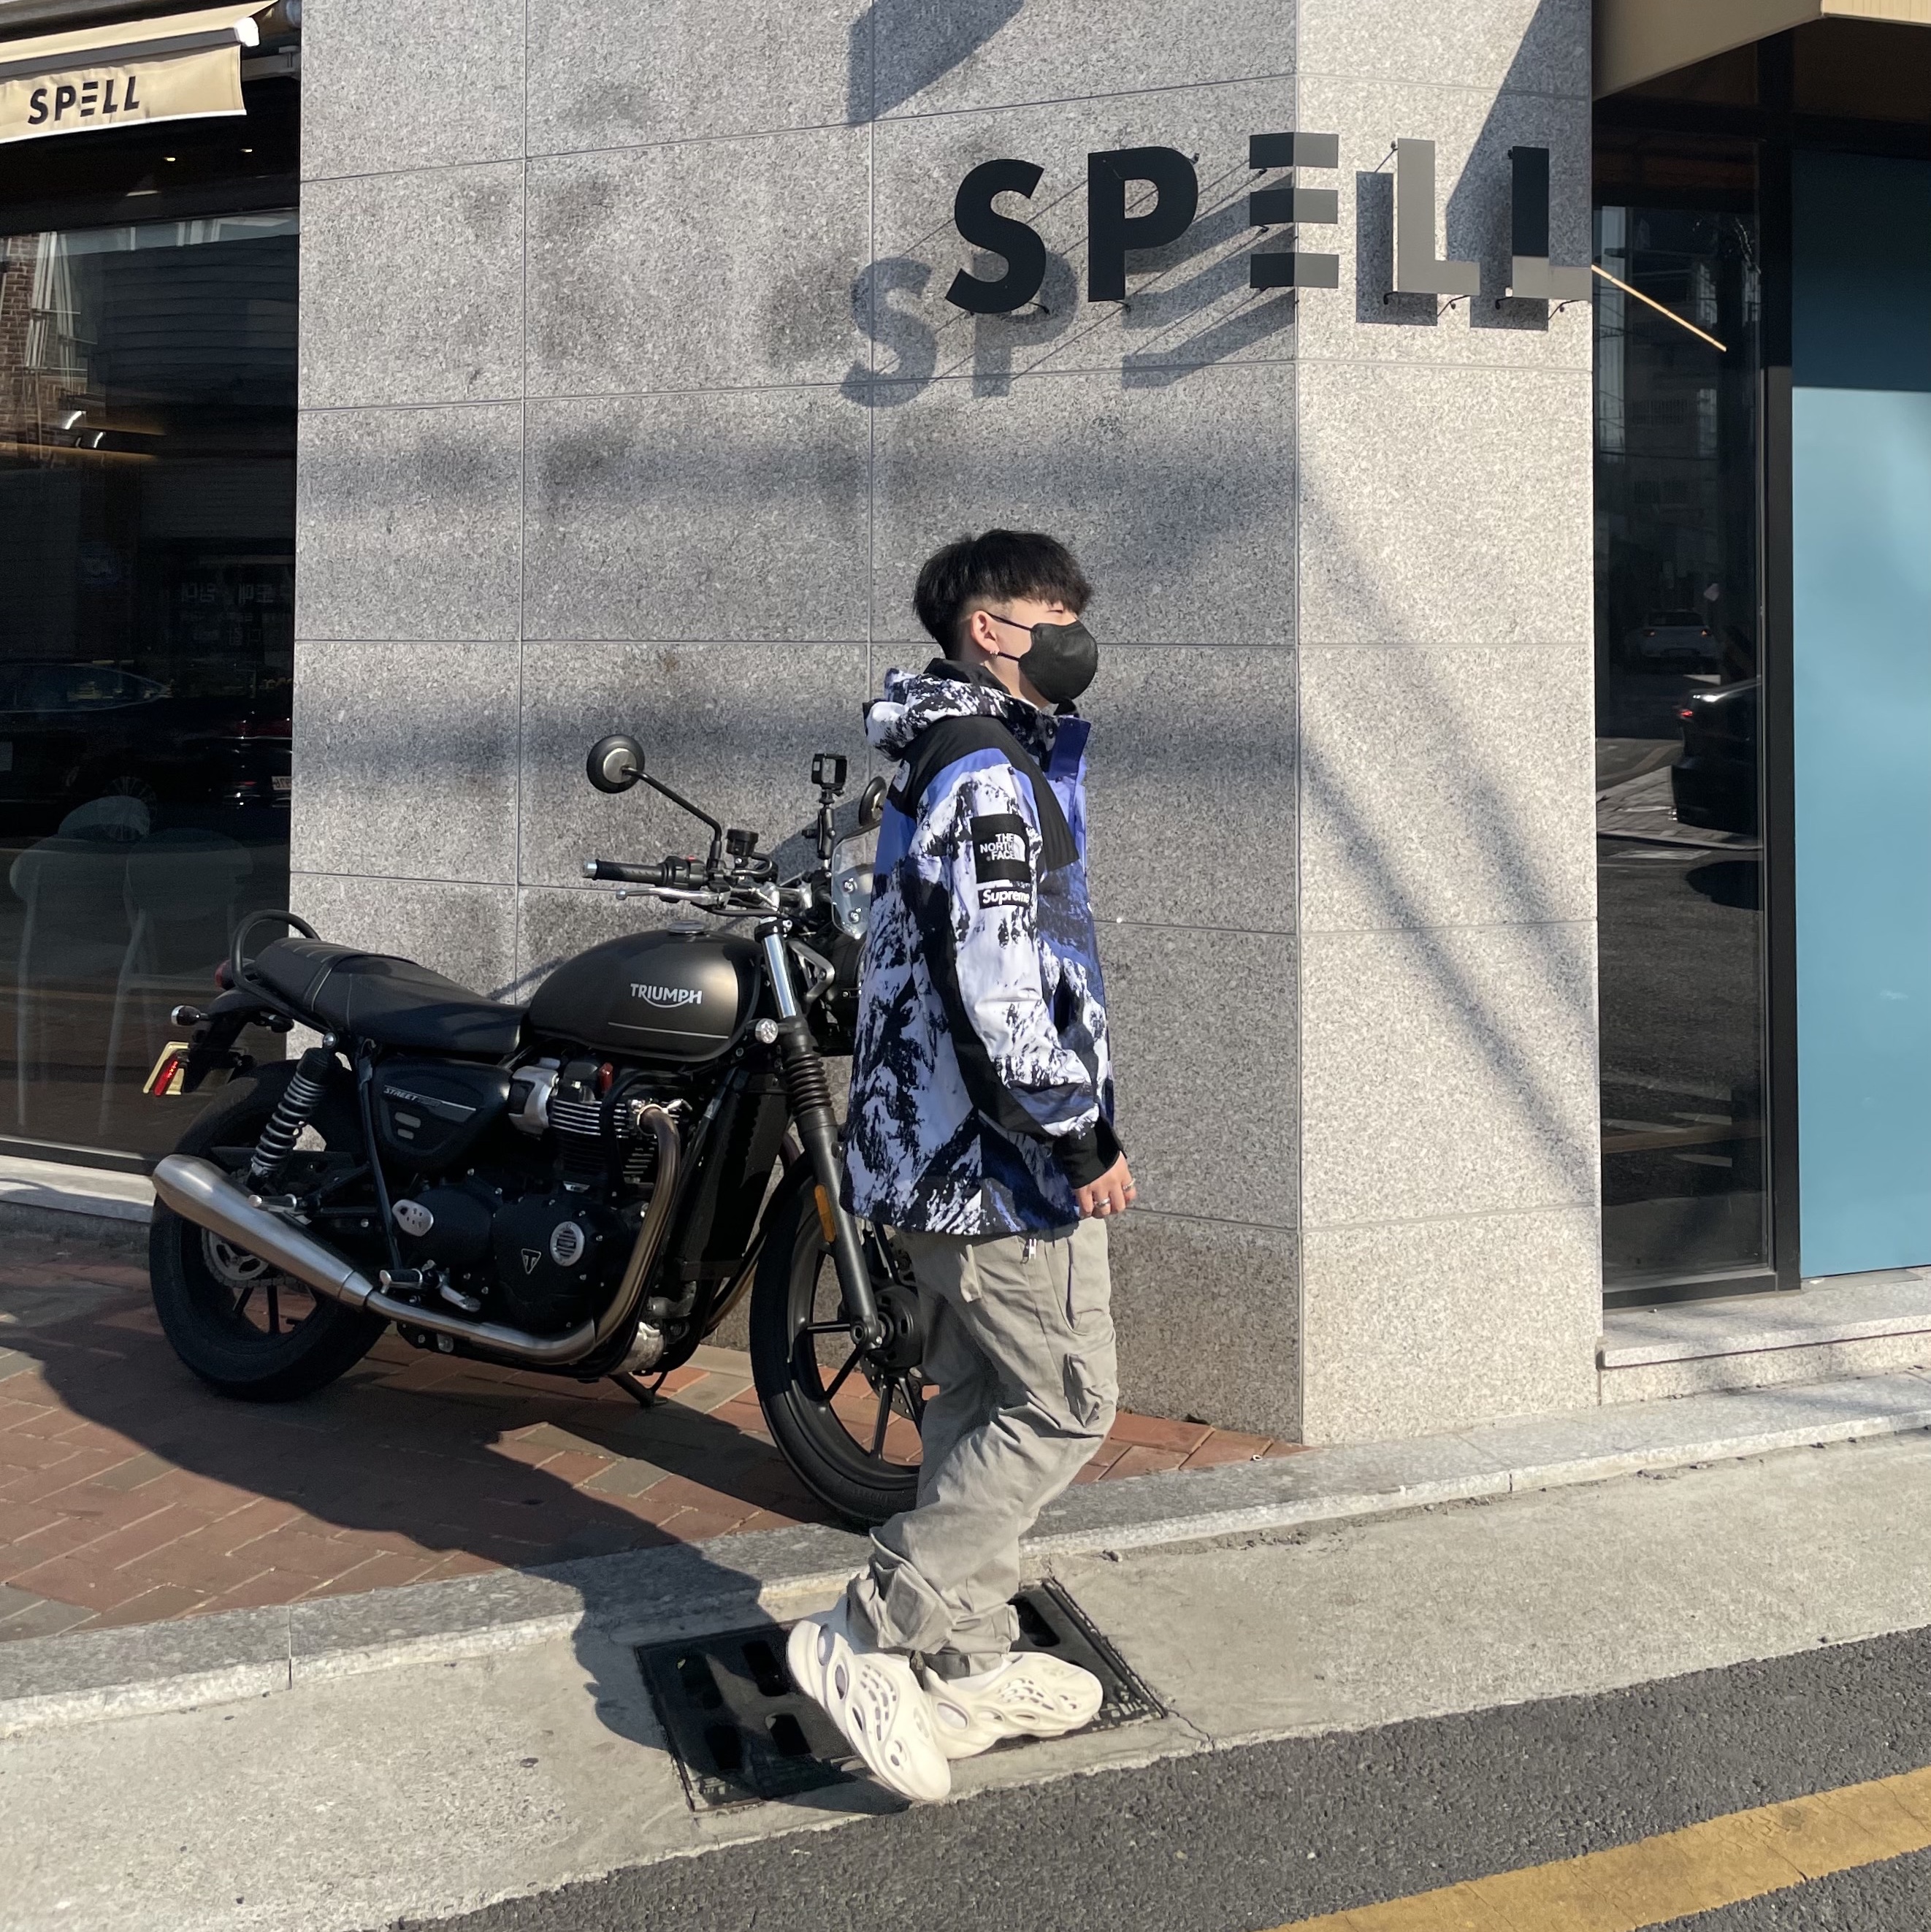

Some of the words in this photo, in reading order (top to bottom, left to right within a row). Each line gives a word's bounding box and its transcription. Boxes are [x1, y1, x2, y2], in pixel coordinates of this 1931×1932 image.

[28, 76, 139, 124] SPELL
[945, 131, 1592, 314] SPELL
[995, 833, 1014, 842] THE
[980, 842, 1014, 853] NORTH
[992, 850, 1016, 860] FACE
[982, 890, 1030, 904] Supreme
[630, 983, 702, 1007] TRIUMPH
[383, 1088, 418, 1101] STREET
